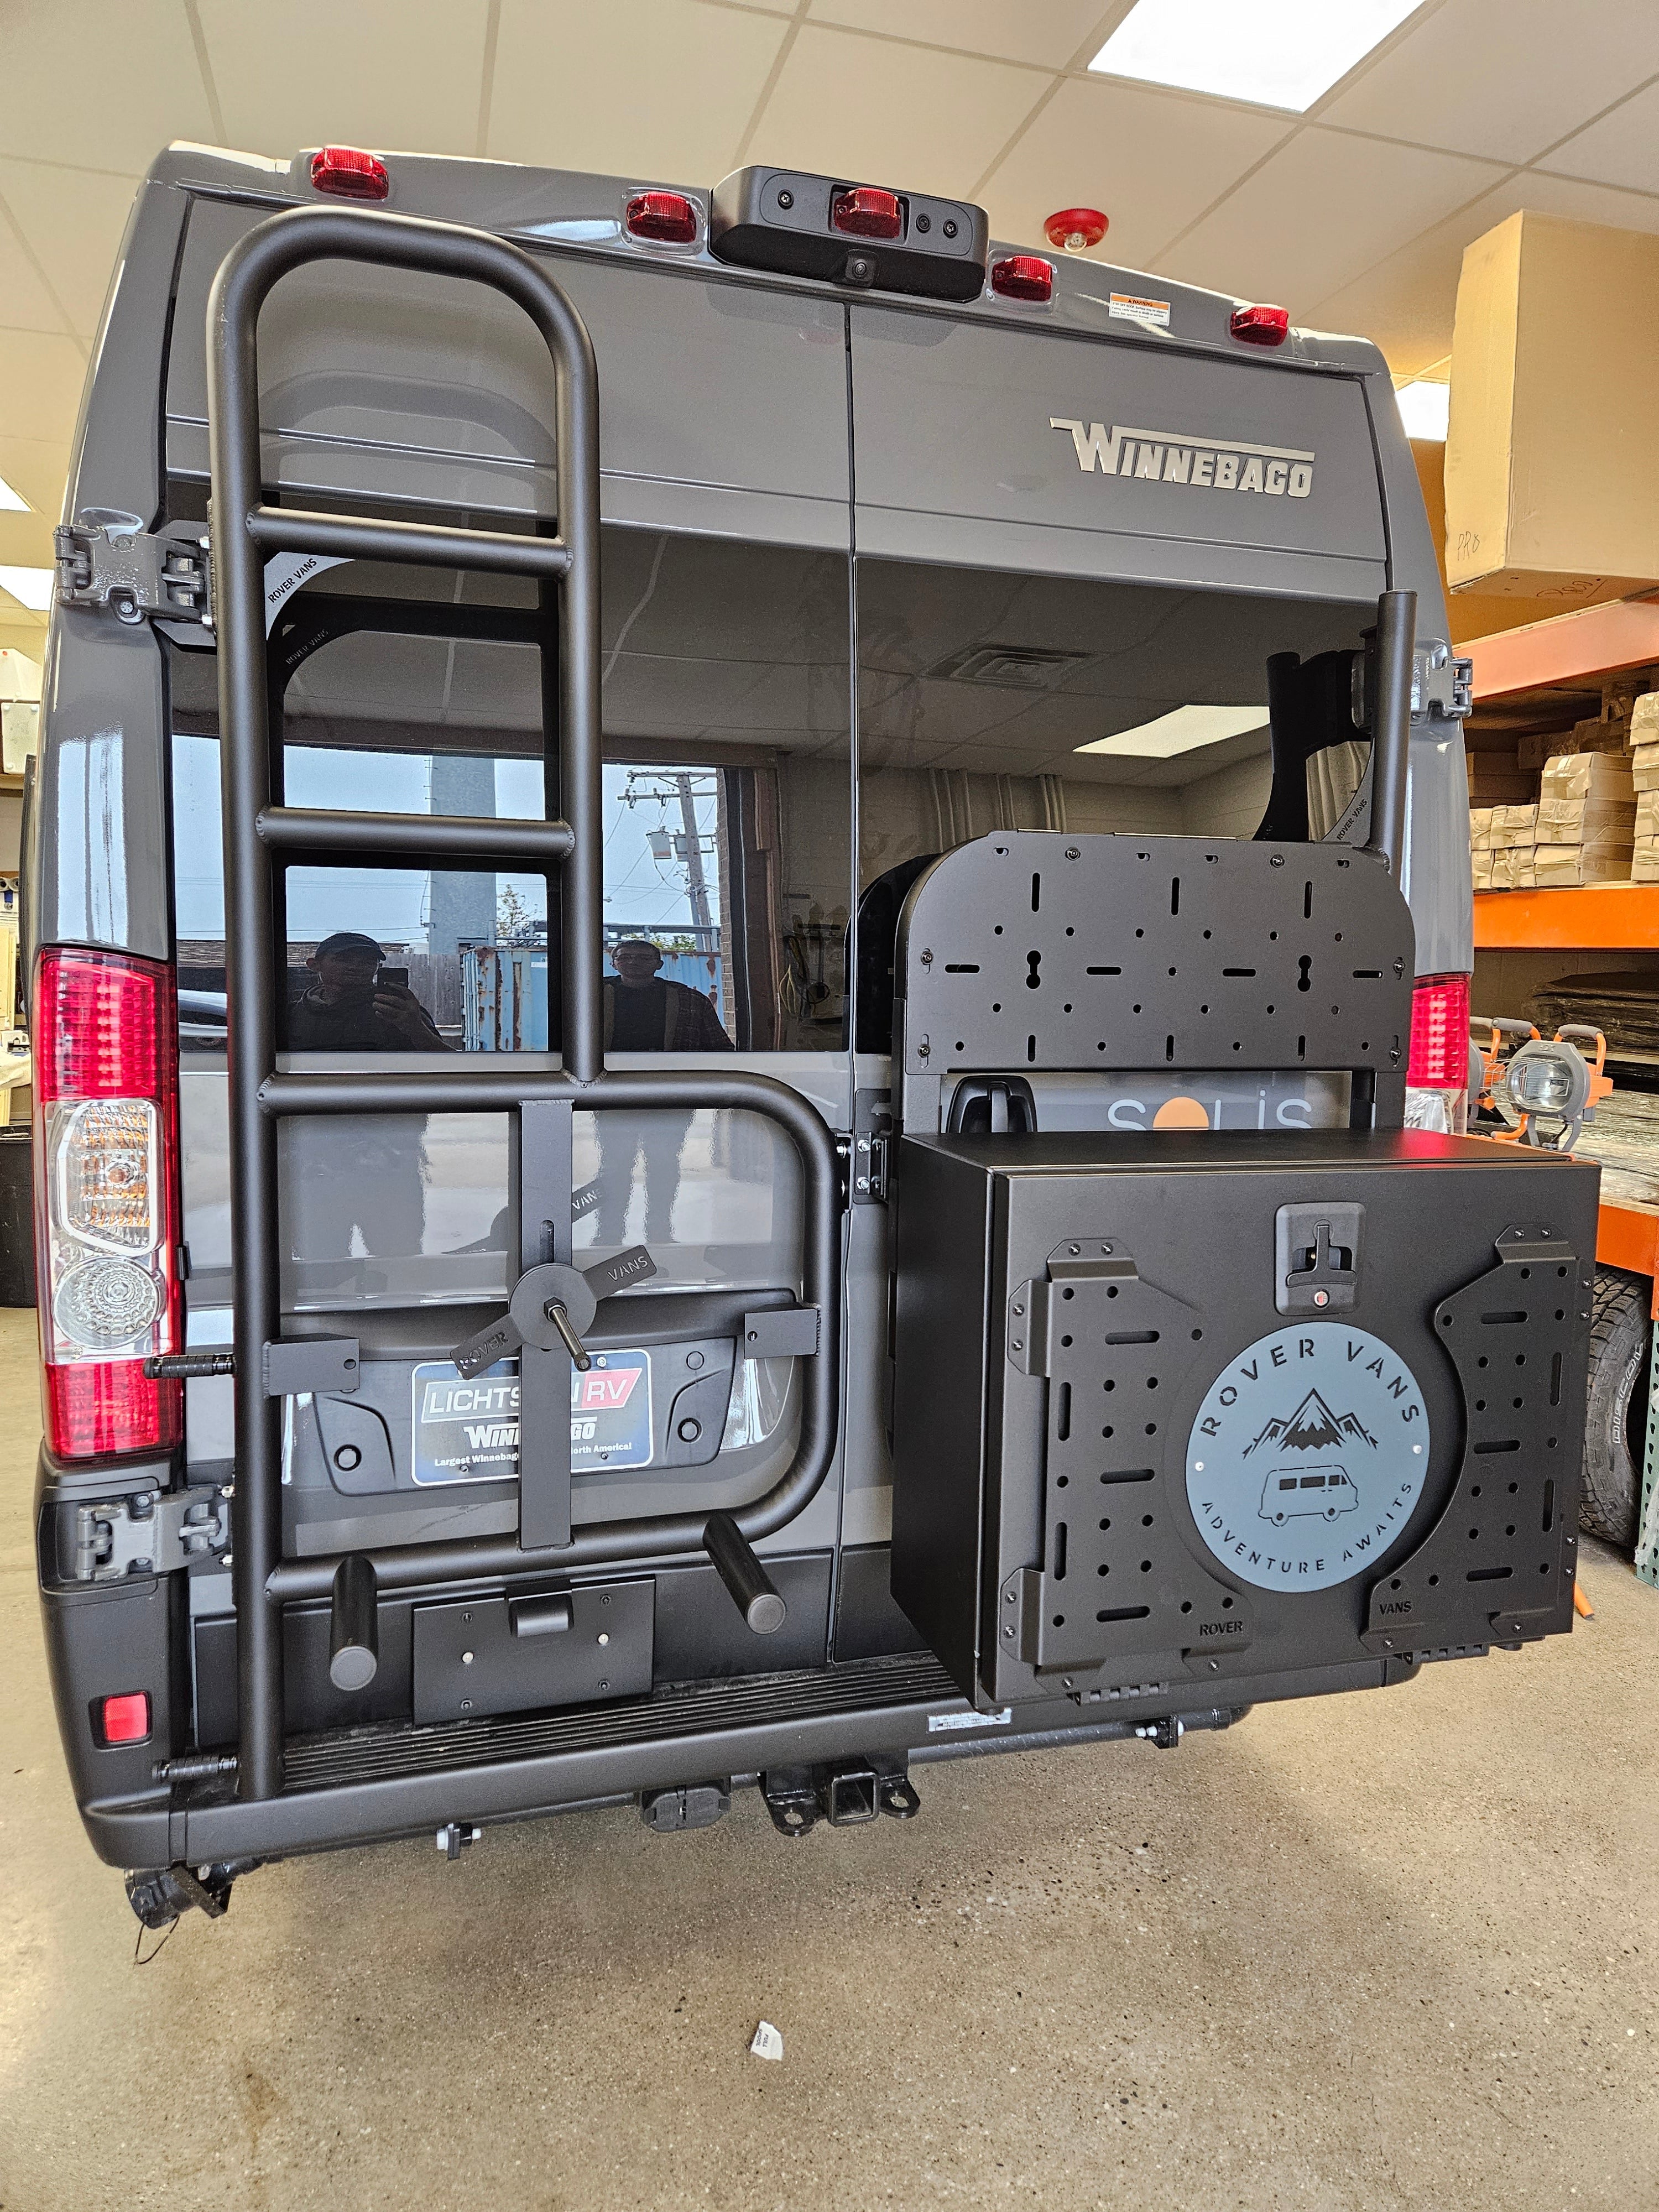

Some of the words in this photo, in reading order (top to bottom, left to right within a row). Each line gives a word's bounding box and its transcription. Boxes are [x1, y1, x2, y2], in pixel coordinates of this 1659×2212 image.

[1049, 417, 1316, 498] WINNEBAGO
[268, 577, 295, 603] ROVER
[293, 558, 317, 579] VANS
[285, 645, 309, 665] ROVER
[309, 628, 328, 646] VANS
[1337, 818, 1354, 841] ROVER
[1352, 799, 1368, 817] VANS
[607, 1256, 648, 1281] VANS
[459, 1332, 509, 1370] ROVER
[587, 1379, 628, 1402] RV
[1200, 1339, 1315, 1437] ROVER
[1347, 1340, 1420, 1423] VANS
[435, 1455, 470, 1467] Largest
[472, 1452, 519, 1464] Winnebag
[571, 1445, 592, 1454] orth
[593, 1442, 632, 1453] America!
[1202, 1501, 1326, 1574] ADVENTURE
[1343, 1482, 1412, 1562] AWAITS
[1379, 1601, 1412, 1615] VANS
[1199, 1620, 1244, 1637] ROVER
